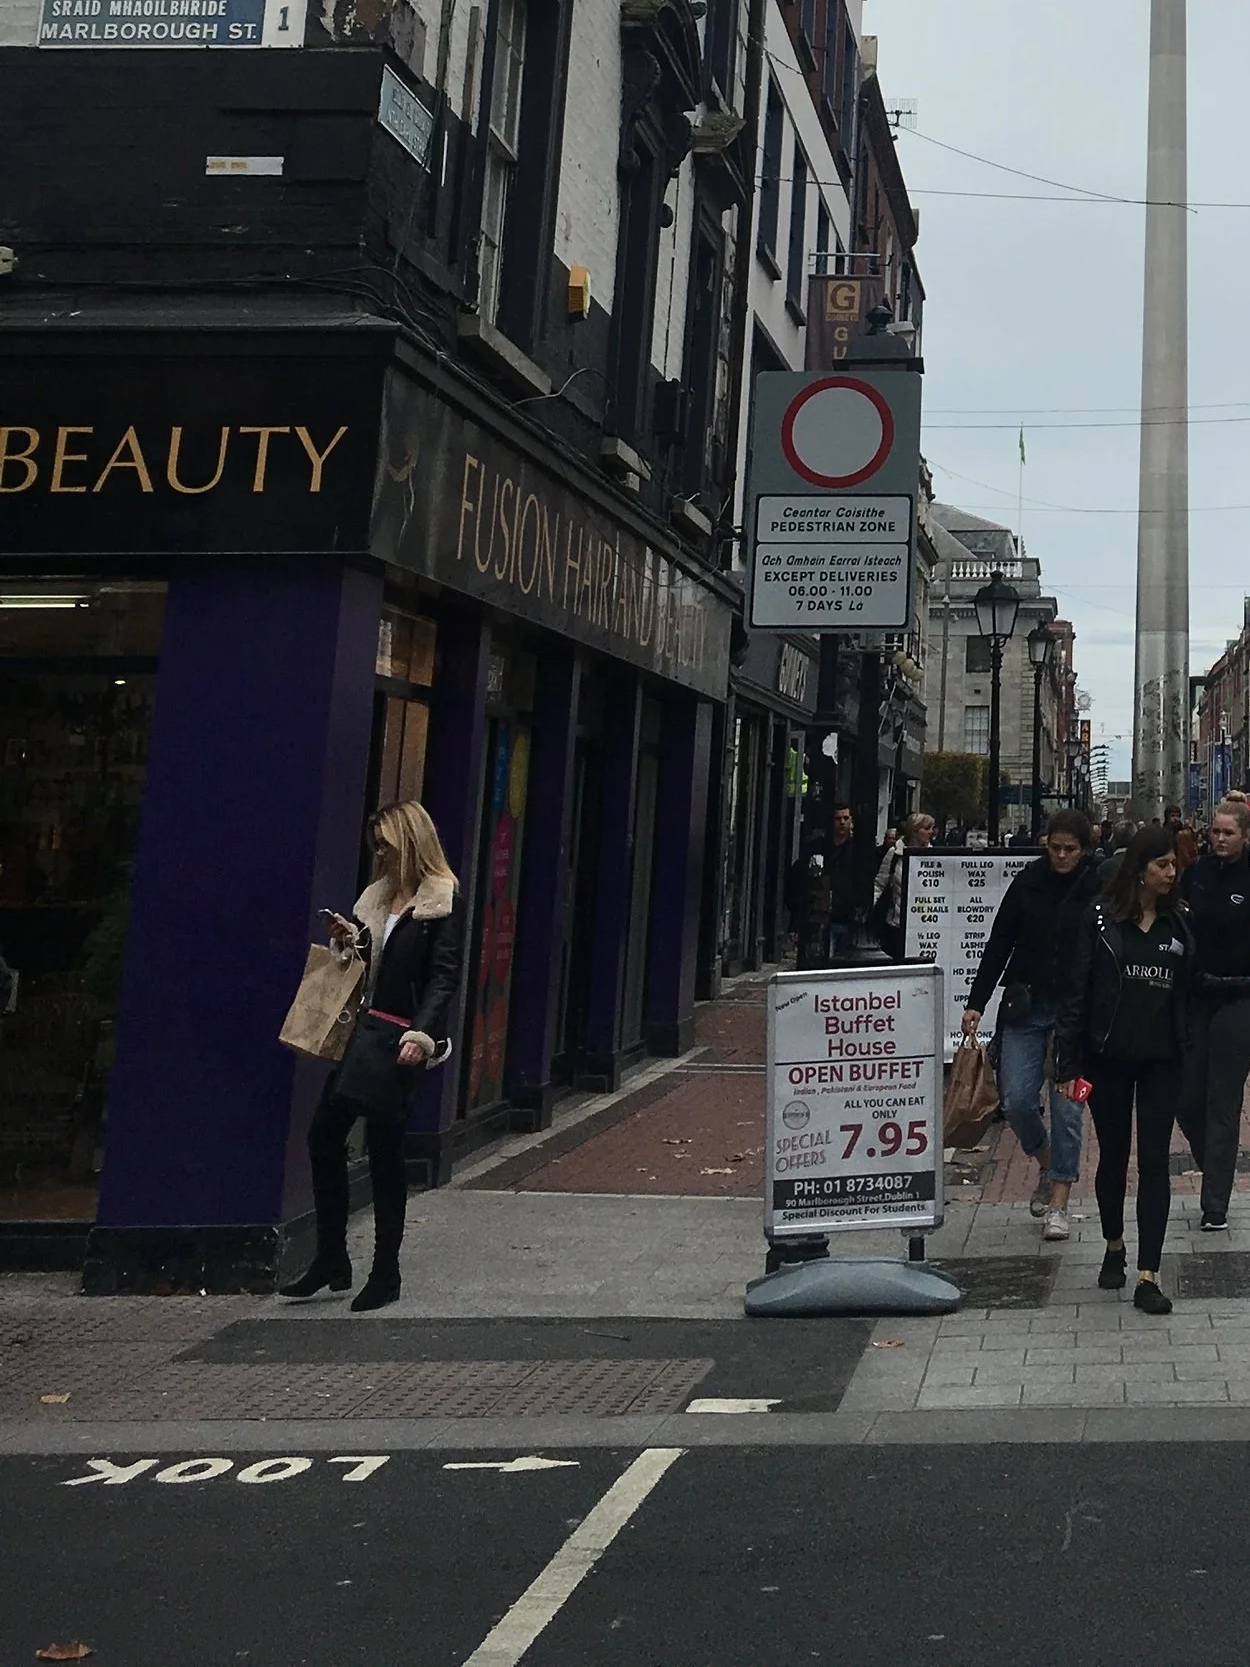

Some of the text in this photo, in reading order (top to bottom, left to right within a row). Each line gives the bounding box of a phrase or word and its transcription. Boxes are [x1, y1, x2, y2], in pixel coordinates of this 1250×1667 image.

[278, 6, 290, 31] 1
[41, 22, 257, 40] MARLBOROUGH ST.
[0, 425, 349, 494] BEAUTY
[783, 507, 886, 518] Ceantar Coisithe
[770, 521, 896, 532] PEDESTRIAN ZONE
[457, 453, 560, 604] FUSION
[563, 520, 610, 631] HAIR
[864, 555, 902, 566] Isteach
[764, 571, 898, 583] EXCEPT DELIVERIES
[788, 586, 828, 597] 06.00
[840, 586, 873, 597] 11.00
[796, 601, 803, 612] 7
[807, 601, 843, 612] DAYS
[920, 861, 935, 869] FILE
[961, 861, 994, 869] FULL LEG
[917, 870, 945, 878] POLISH
[967, 870, 986, 878] WAX
[922, 879, 940, 888] €10
[968, 879, 986, 888] €25
[914, 896, 946, 904] FULL SET
[969, 896, 983, 904] ALL
[957, 905, 995, 914] BLOWDRY
[921, 914, 938, 924] €40
[966, 914, 985, 923] €20
[926, 932, 941, 940] LEG
[964, 932, 986, 940] STRIP
[919, 941, 938, 949] WAX
[790, 991, 808, 1005] Open
[814, 990, 901, 1013] Istanbel
[824, 1014, 895, 1035] Buffet
[827, 1038, 897, 1058] House
[788, 1061, 924, 1085] OPEN BUFFET
[898, 1081, 917, 1090] Food
[843, 1096, 926, 1109] ALL YOU CAN EAT
[872, 1110, 898, 1120] ONLY
[775, 1130, 833, 1155] SPECIAL
[839, 1120, 929, 1160] 7.95
[775, 1149, 827, 1173] OFFERS
[793, 1175, 913, 1196] PH: 01 8734087
[785, 1199, 797, 1208] 90
[798, 1195, 855, 1208] Marlborough
[916, 1191, 921, 1199] 1
[782, 1202, 926, 1221] Special Discount For Students
[57, 1455, 391, 1486] LOOK
